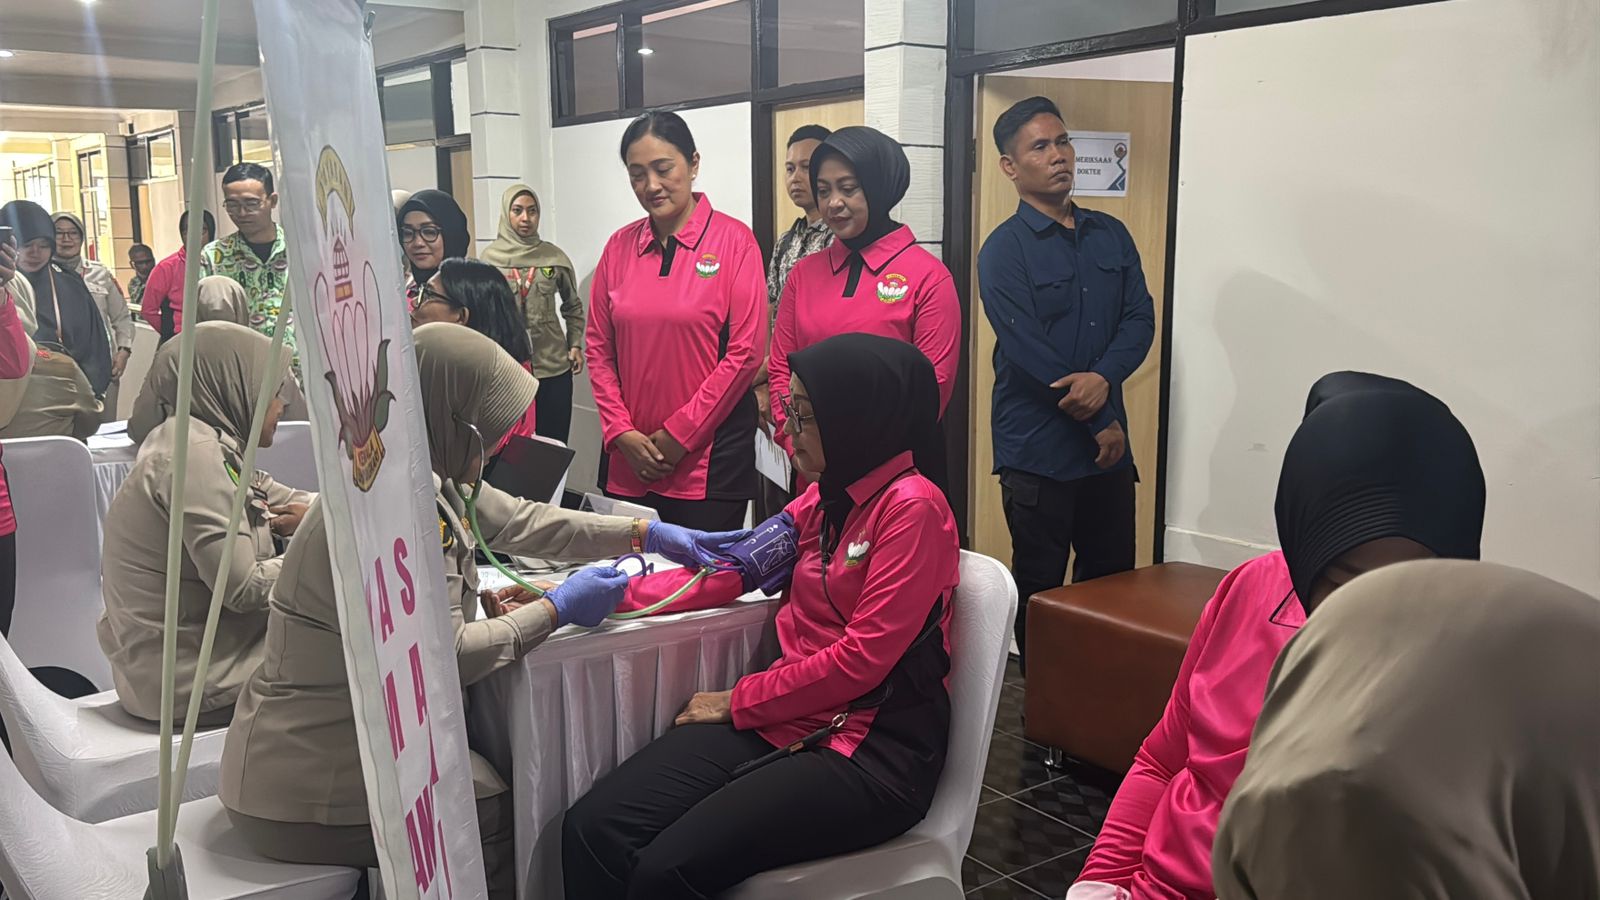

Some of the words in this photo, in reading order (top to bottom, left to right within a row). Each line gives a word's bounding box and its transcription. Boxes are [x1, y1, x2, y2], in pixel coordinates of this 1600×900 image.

[1075, 156, 1113, 164] MERIKSAAN
[1077, 168, 1102, 176] DOKTER
[365, 537, 416, 644] AS
